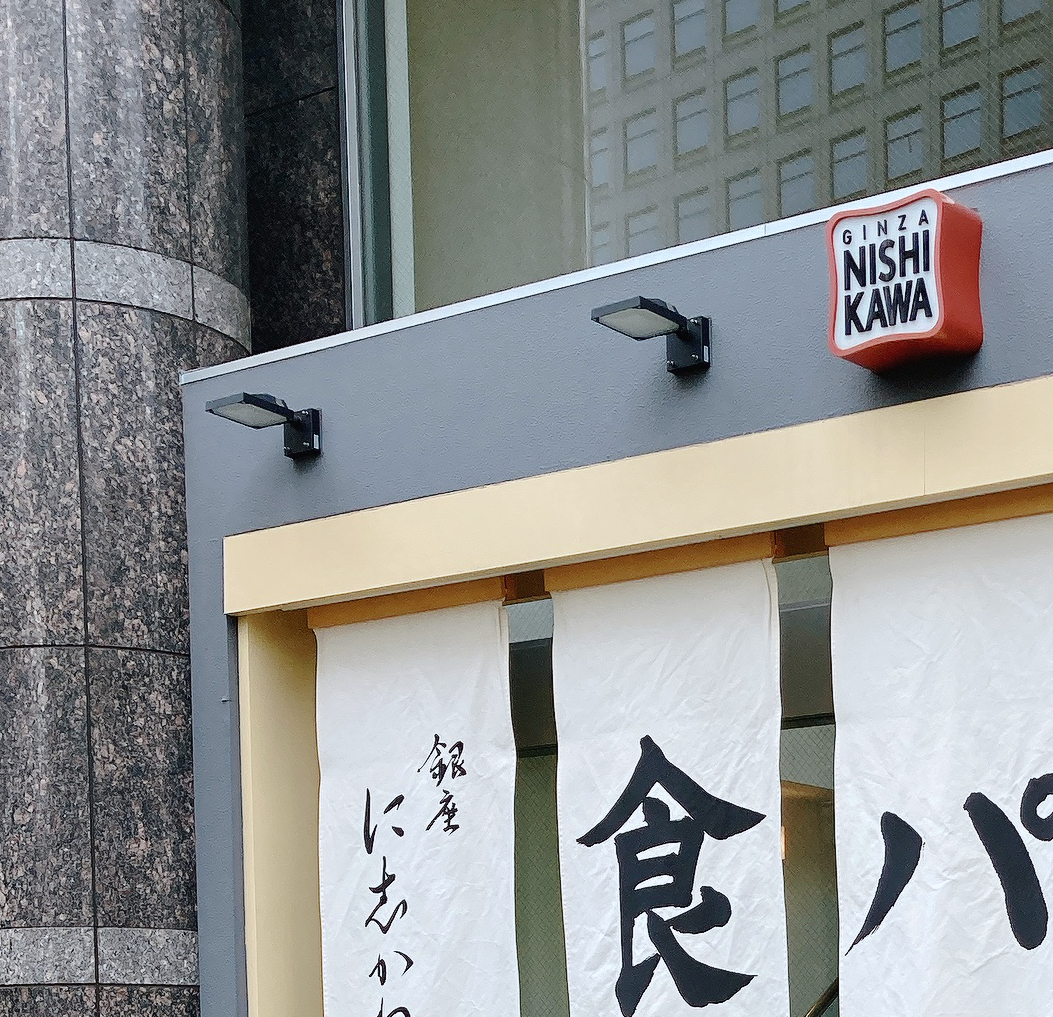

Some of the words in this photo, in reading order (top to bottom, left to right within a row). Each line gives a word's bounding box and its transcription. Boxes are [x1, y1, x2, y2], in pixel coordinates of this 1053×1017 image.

[842, 209, 929, 245] GINZA
[843, 229, 930, 291] NISHI
[844, 277, 933, 336] KAWA
[417, 733, 467, 836] 銀座
